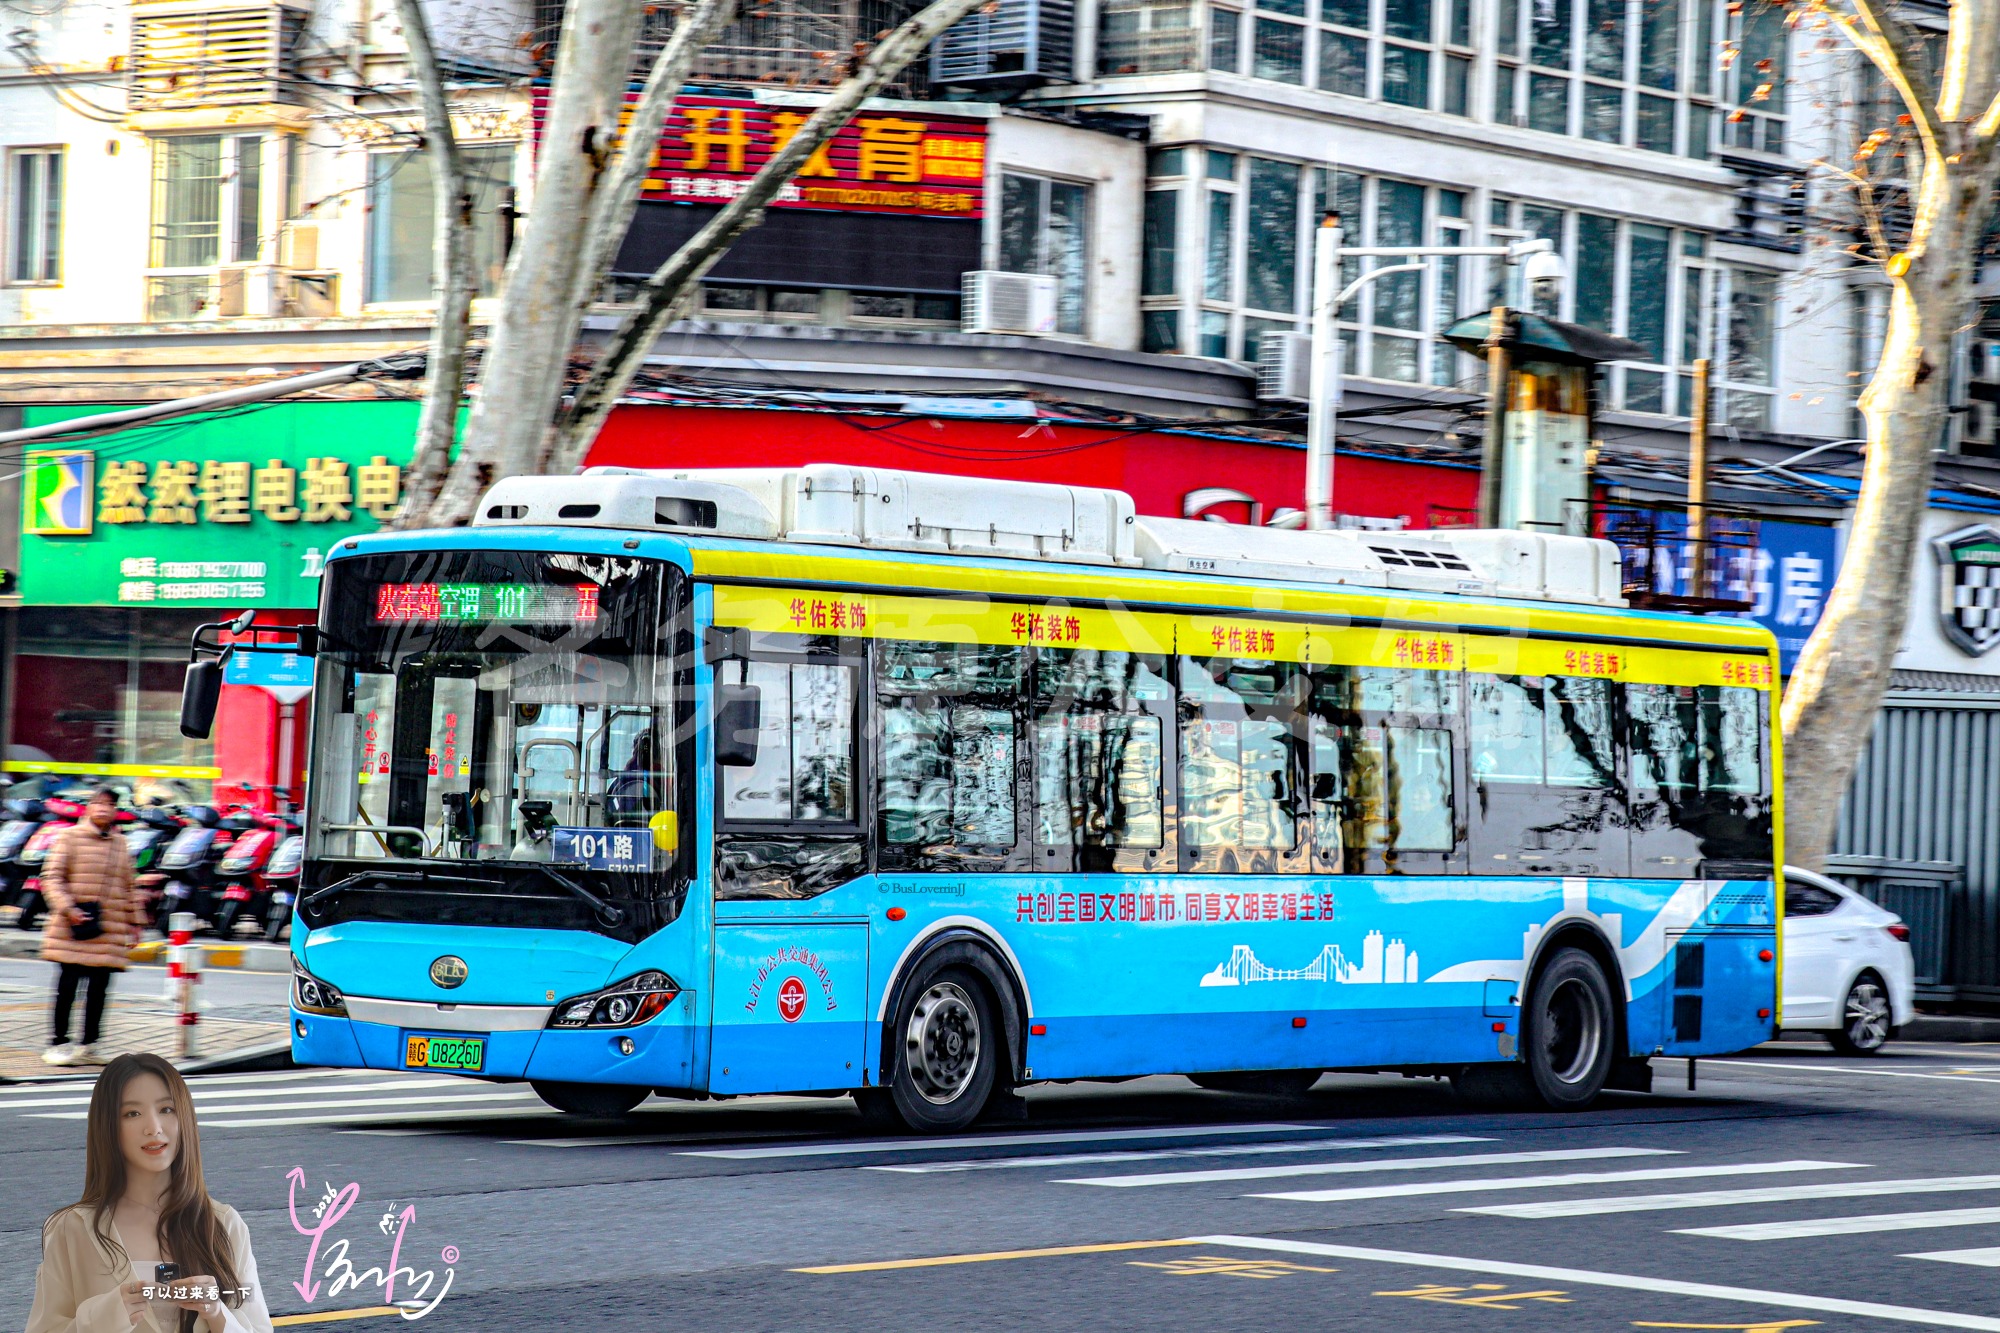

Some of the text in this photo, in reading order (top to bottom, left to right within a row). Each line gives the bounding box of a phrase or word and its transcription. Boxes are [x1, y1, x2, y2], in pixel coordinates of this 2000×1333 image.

[98, 456, 401, 524] 然然锂电换电
[495, 586, 526, 618] 101
[790, 598, 867, 629] 华佑装饰
[1011, 612, 1081, 642] 华佑装饰
[1211, 627, 1275, 654] 华佑装饰
[1396, 638, 1453, 663] 华佑装饰
[1565, 650, 1619, 675] 华佑装饰
[1722, 661, 1773, 684] 华佑装饰
